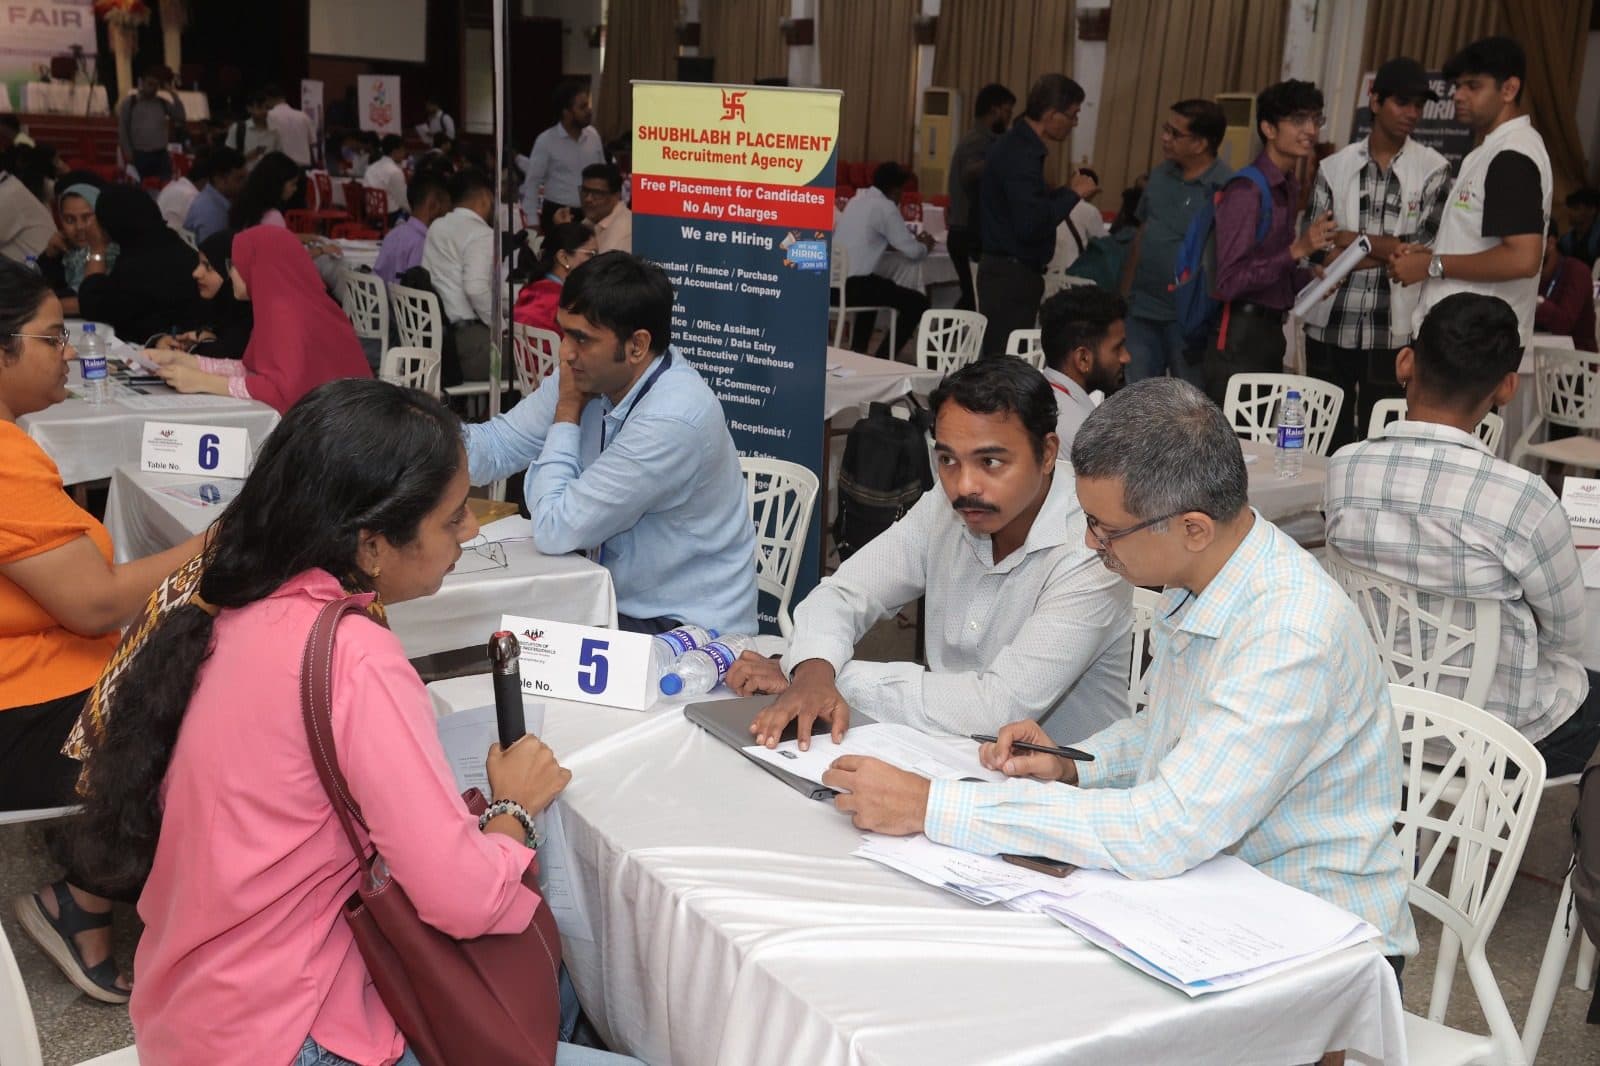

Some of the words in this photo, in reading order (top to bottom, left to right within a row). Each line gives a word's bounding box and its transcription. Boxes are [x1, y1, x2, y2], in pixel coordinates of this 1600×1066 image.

[8, 6, 82, 28] FAIR
[638, 126, 731, 145] SHUBHLABH
[736, 132, 831, 151] PLACEMENT
[662, 147, 747, 165] Recruitment
[751, 153, 803, 173] Agency
[640, 178, 666, 192] Free
[669, 180, 732, 198] Placement
[736, 185, 753, 199] for
[756, 187, 825, 205] Candidates
[683, 201, 699, 213] No
[703, 203, 724, 218] Any
[728, 204, 778, 222] Charges
[681, 226, 701, 240] We
[705, 231, 727, 242] are
[732, 231, 773, 250] Hiring
[791, 248, 824, 260] HIRING
[696, 264, 729, 277] Finance
[737, 268, 779, 282] Purchase
[684, 276, 733, 291] Accountant
[741, 283, 782, 298] Company
[697, 320, 721, 332] Office
[723, 323, 760, 336] Assitant
[682, 331, 723, 346] Executive
[731, 338, 752, 350] Data
[754, 341, 776, 355] Entry
[688, 359, 735, 374] torekeeper
[697, 347, 739, 361] Executive
[746, 354, 794, 369] Warehouse
[716, 377, 771, 394] E-Commerce
[716, 391, 761, 406] Animation
[731, 420, 786, 437] Receptionist
[198, 433, 220, 470] 6
[148, 461, 167, 470] Table
[1569, 514, 1587, 524] able
[577, 638, 610, 695] 5
[535, 680, 553, 692] No.
